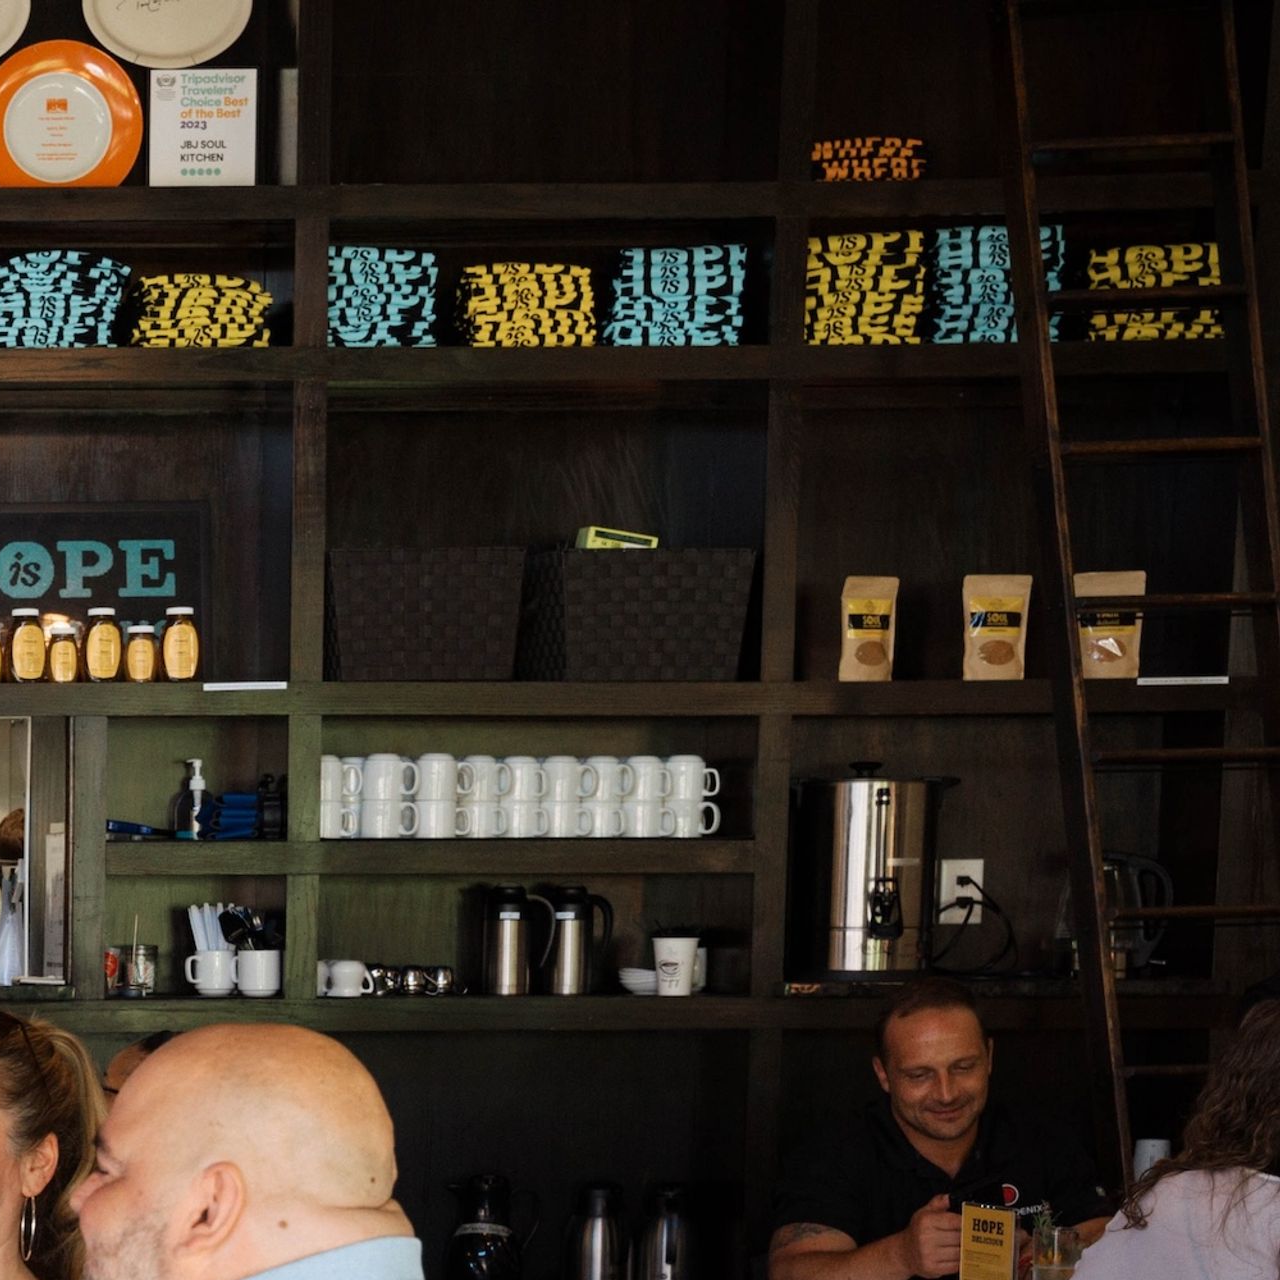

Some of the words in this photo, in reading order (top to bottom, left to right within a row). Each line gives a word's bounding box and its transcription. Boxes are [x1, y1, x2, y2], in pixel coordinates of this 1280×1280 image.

[180, 73, 246, 85] Tripadvisor
[180, 84, 237, 95] Travelers'
[180, 96, 222, 107] Choice
[223, 96, 249, 106] Best
[180, 108, 194, 119] of
[195, 108, 214, 119] the
[216, 108, 241, 118] Best
[180, 120, 208, 130] 2023
[180, 140, 199, 149] JBJ
[200, 140, 227, 149] SOUL
[180, 153, 224, 162] KITCHEN
[8, 551, 42, 588] is
[862, 615, 881, 625] SOUL
[986, 613, 1008, 623] SOUL
[971, 1217, 1005, 1236] HOPE
